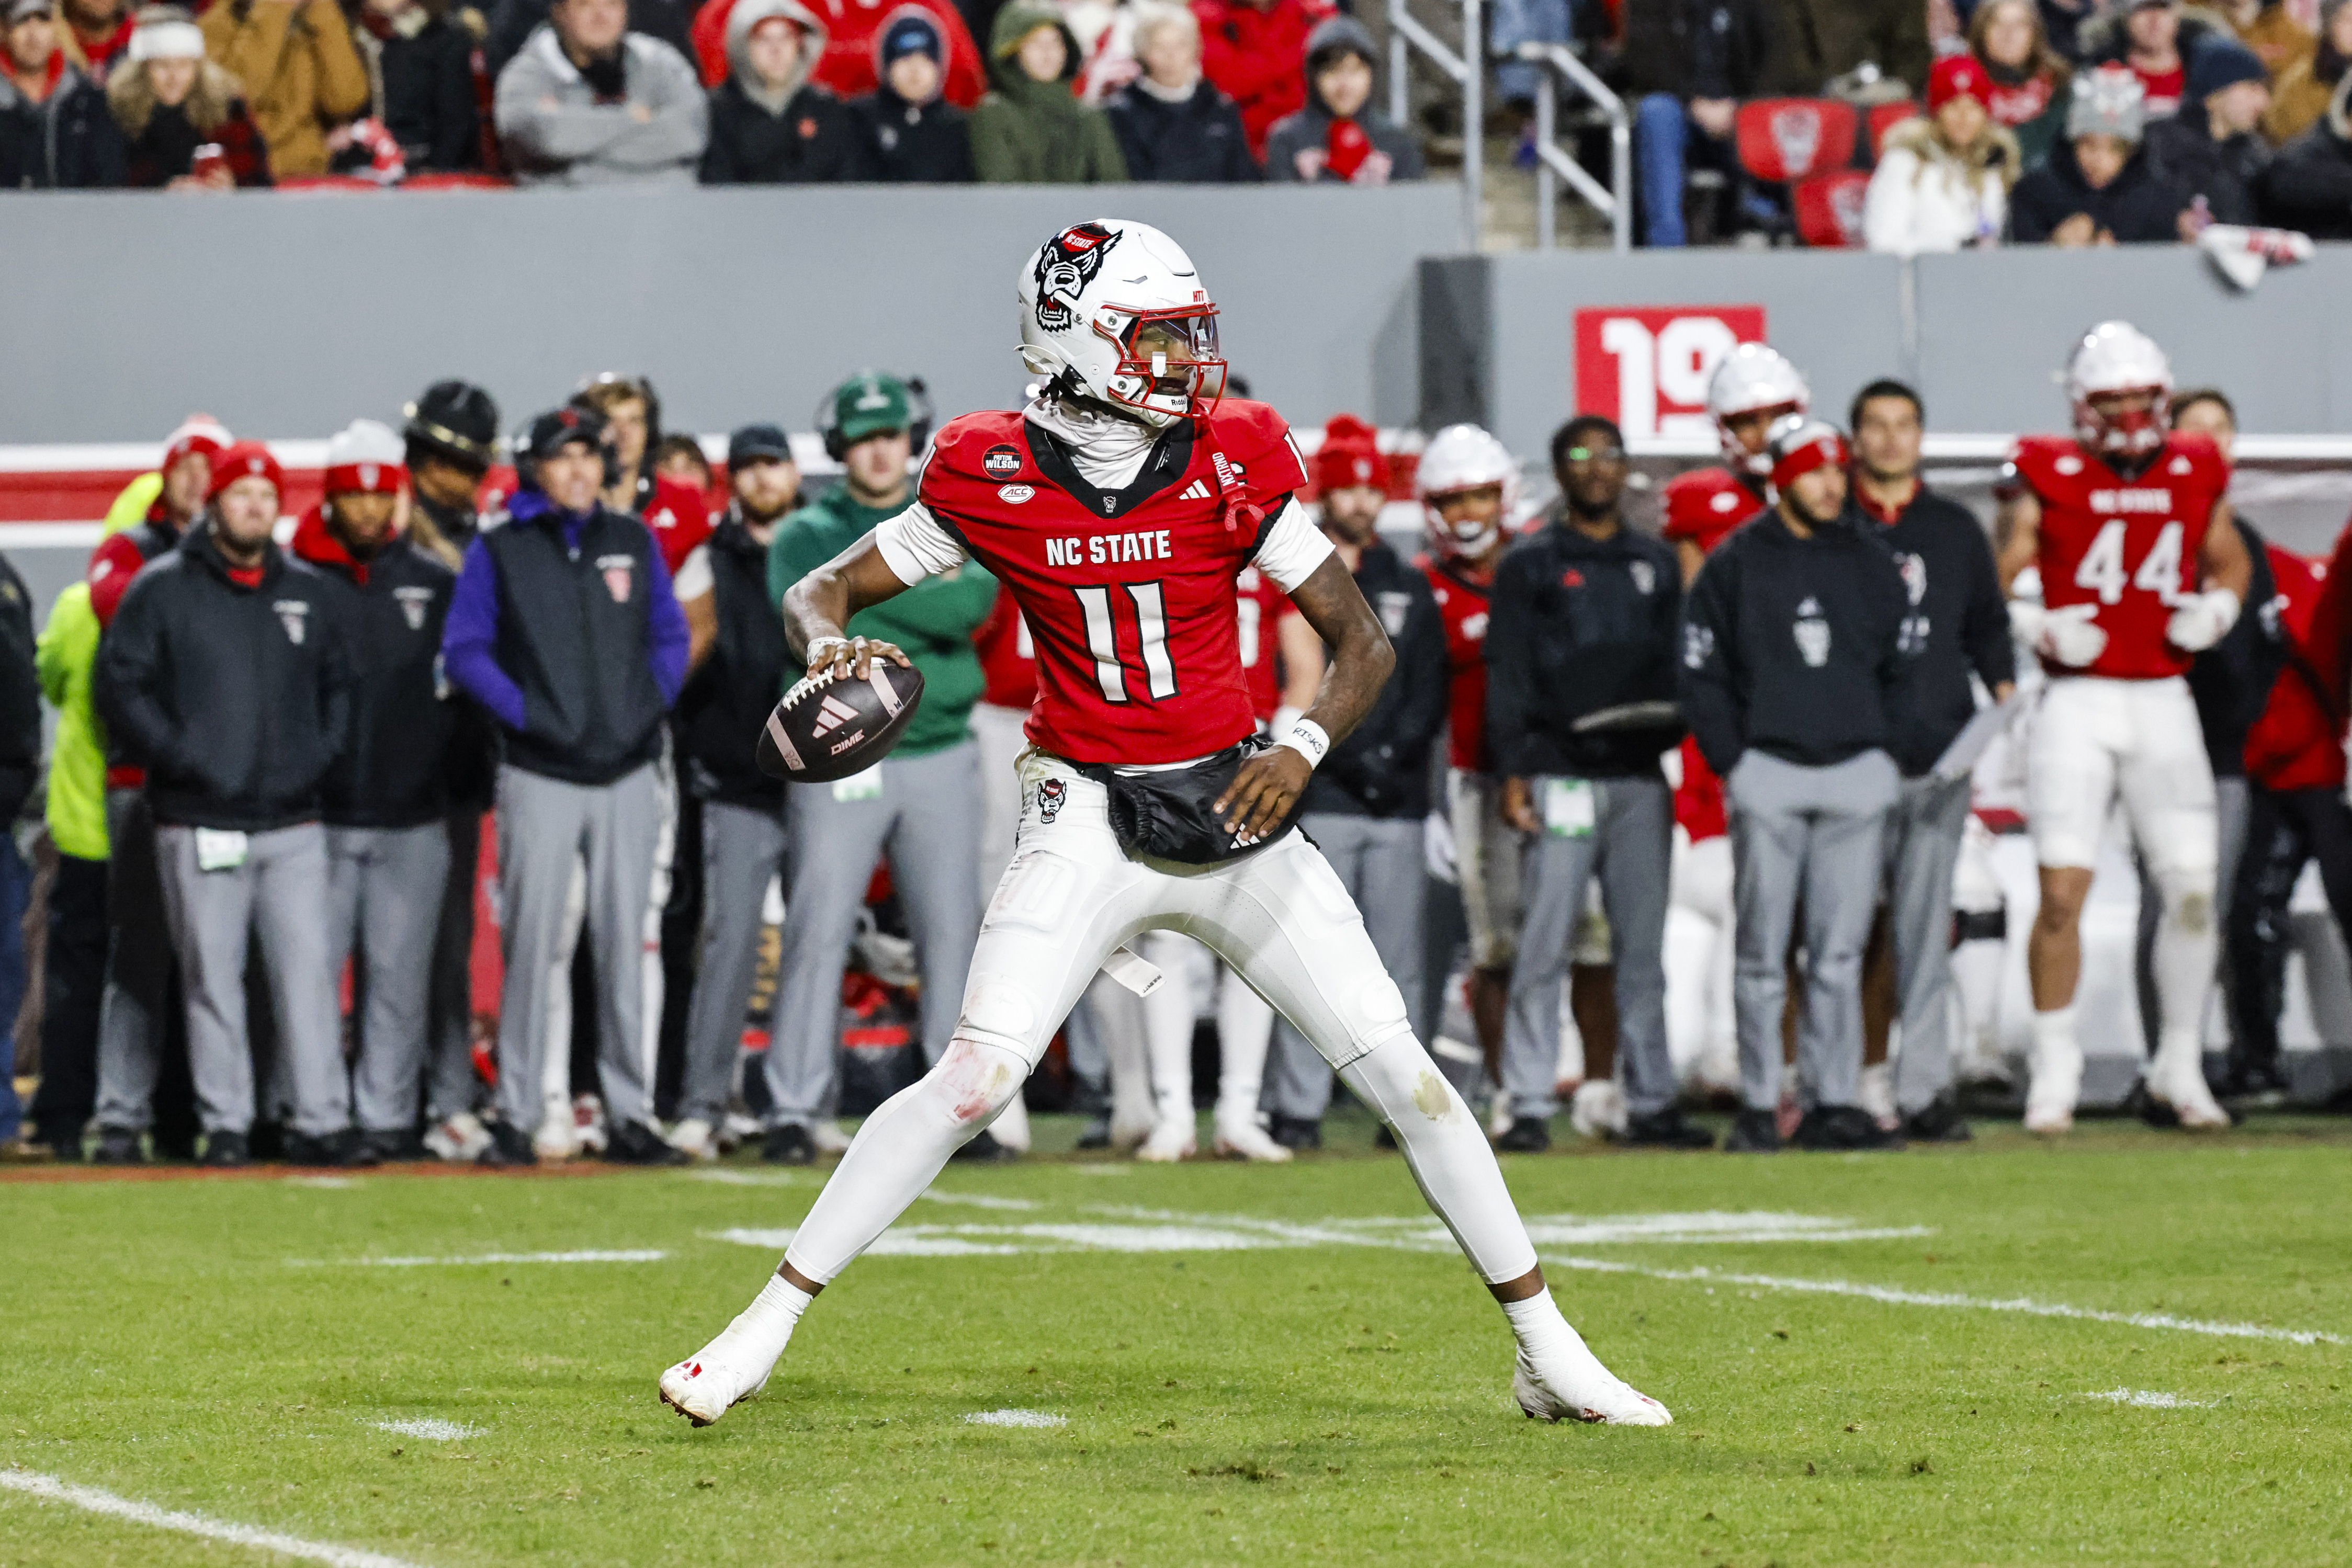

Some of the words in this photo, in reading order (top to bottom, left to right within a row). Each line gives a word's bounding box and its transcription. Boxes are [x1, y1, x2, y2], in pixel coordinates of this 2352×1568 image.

[1065, 233, 1076, 243] NC
[1071, 237, 1095, 248] STATE
[1193, 290, 1204, 302] HTT
[1601, 316, 1738, 437] 19
[986, 460, 1020, 469] WILSON
[1212, 452, 1236, 486] NXTRND
[1046, 537, 1082, 566] NC
[1090, 529, 1172, 564] STATE
[2074, 518, 2185, 607] 44
[1071, 580, 1180, 706] 11
[831, 729, 865, 755] DIME
[1293, 727, 1323, 755] RISKS
